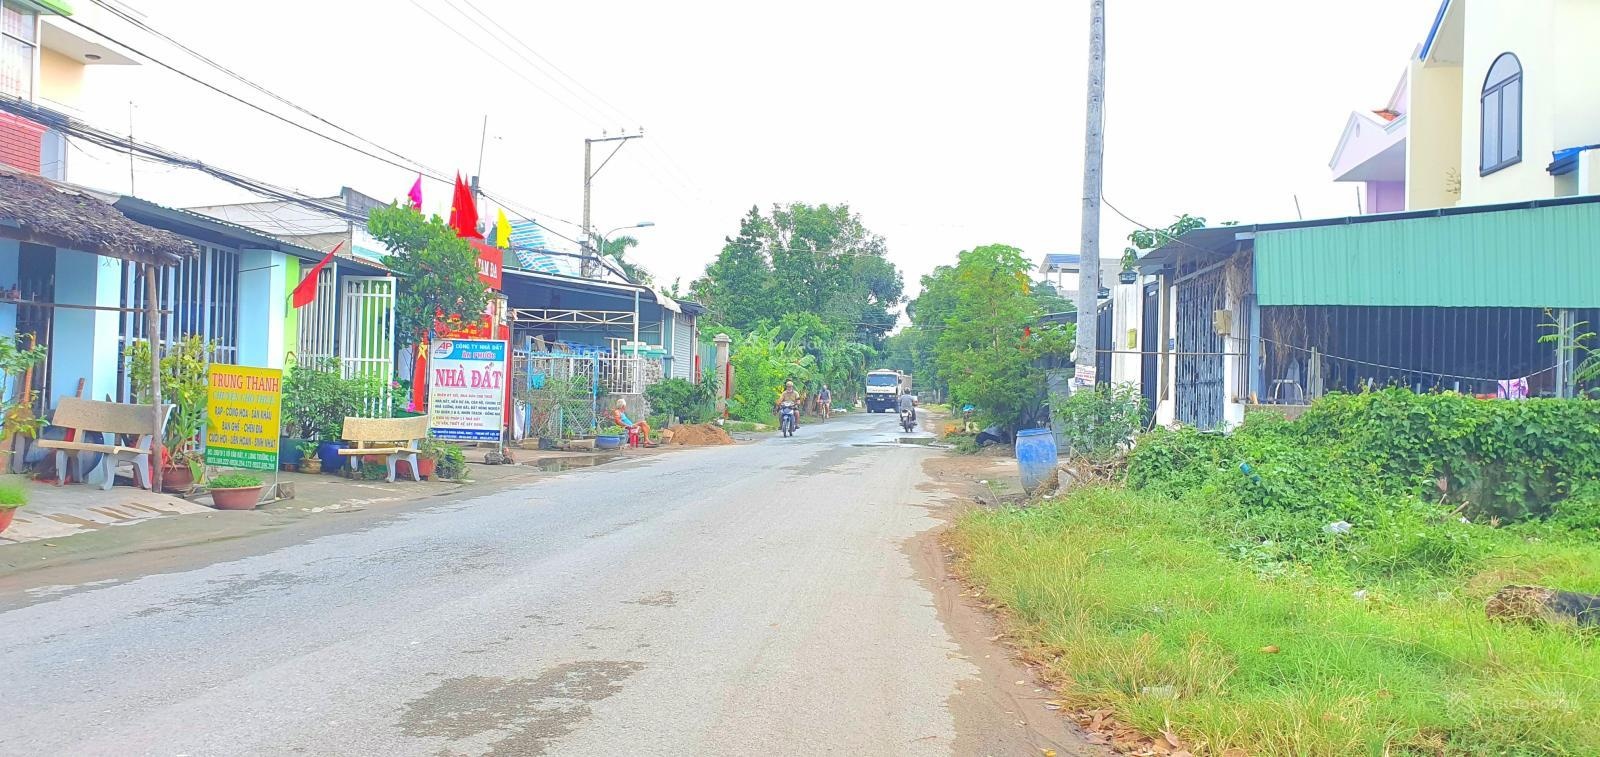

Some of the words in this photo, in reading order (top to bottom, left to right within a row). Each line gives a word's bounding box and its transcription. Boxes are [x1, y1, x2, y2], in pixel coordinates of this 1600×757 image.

[212, 372, 244, 389] TRUNG
[435, 364, 467, 388] NHÀ
[471, 362, 502, 389] ĐẤT
